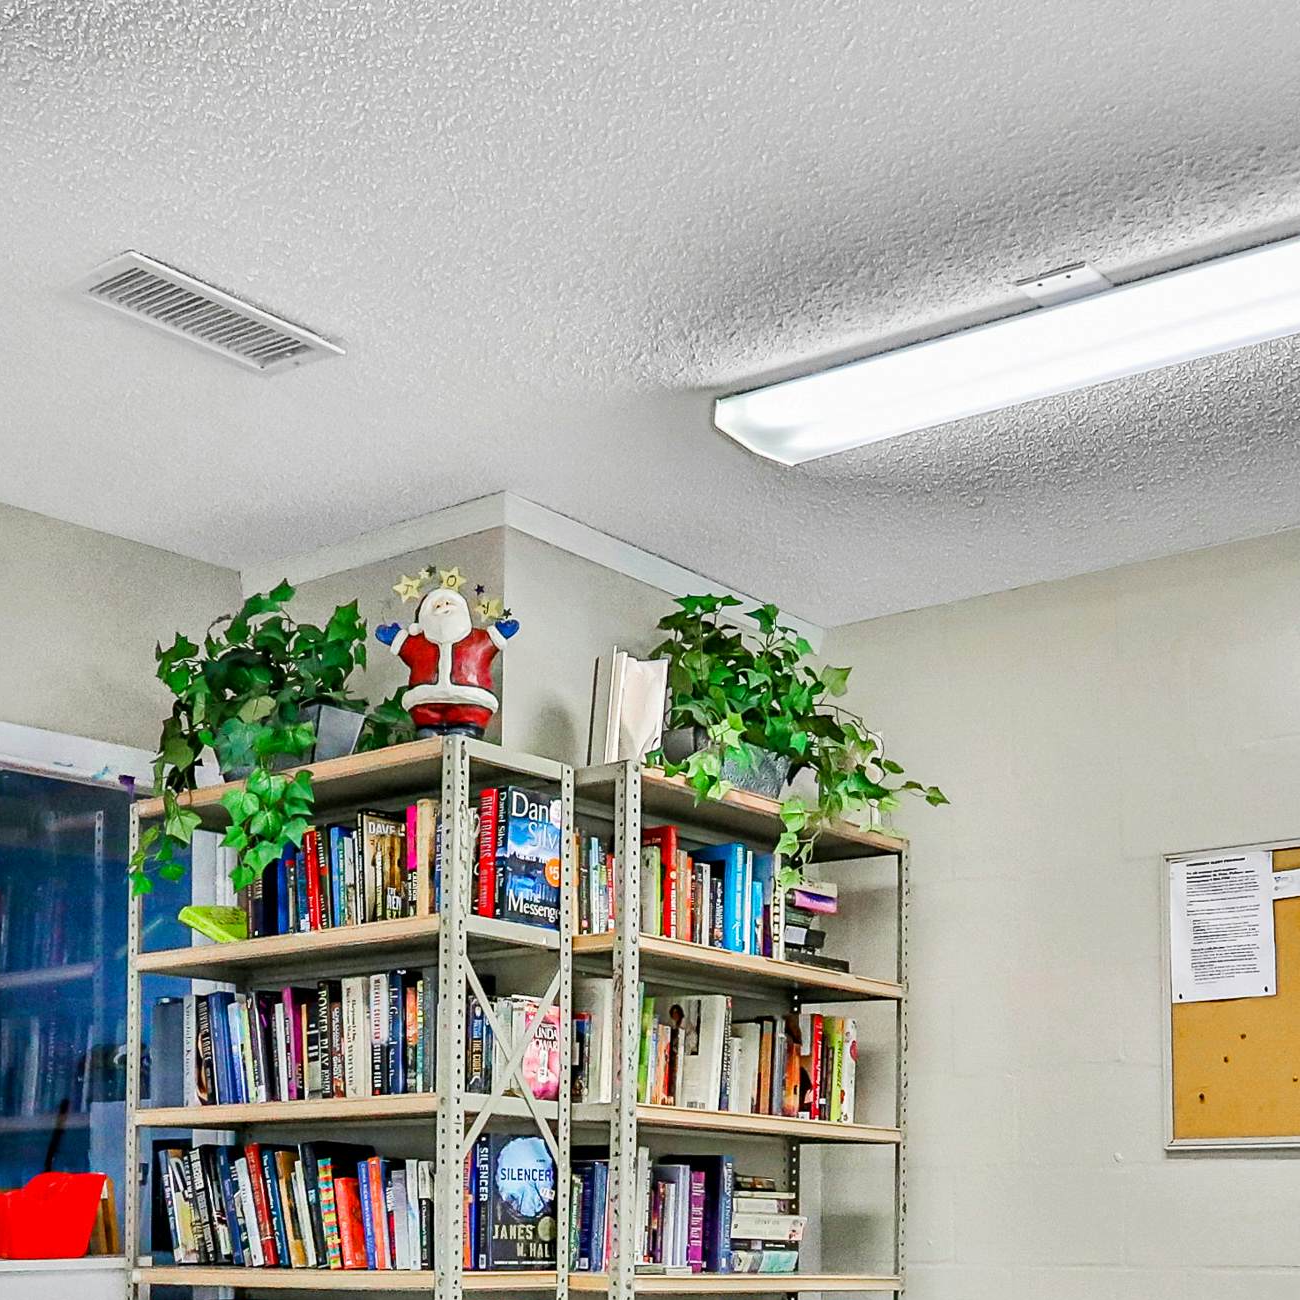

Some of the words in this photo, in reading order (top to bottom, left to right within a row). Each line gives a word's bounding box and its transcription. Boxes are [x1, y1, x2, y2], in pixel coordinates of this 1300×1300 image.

[498, 792, 507, 824] Daniel
[481, 820, 493, 859] FRANCIS
[497, 825, 506, 847] Silva
[528, 821, 562, 850] Silv
[198, 1001, 210, 1034] DRIVING
[318, 990, 328, 1033] POWER
[202, 1036, 211, 1061] FORCE
[320, 1038, 329, 1066] PLAY
[479, 1147, 488, 1202] SILENCER
[500, 1168, 552, 1181] SILENCER
[725, 1162, 733, 1196] PENNY
[492, 1224, 535, 1240] JAMES
